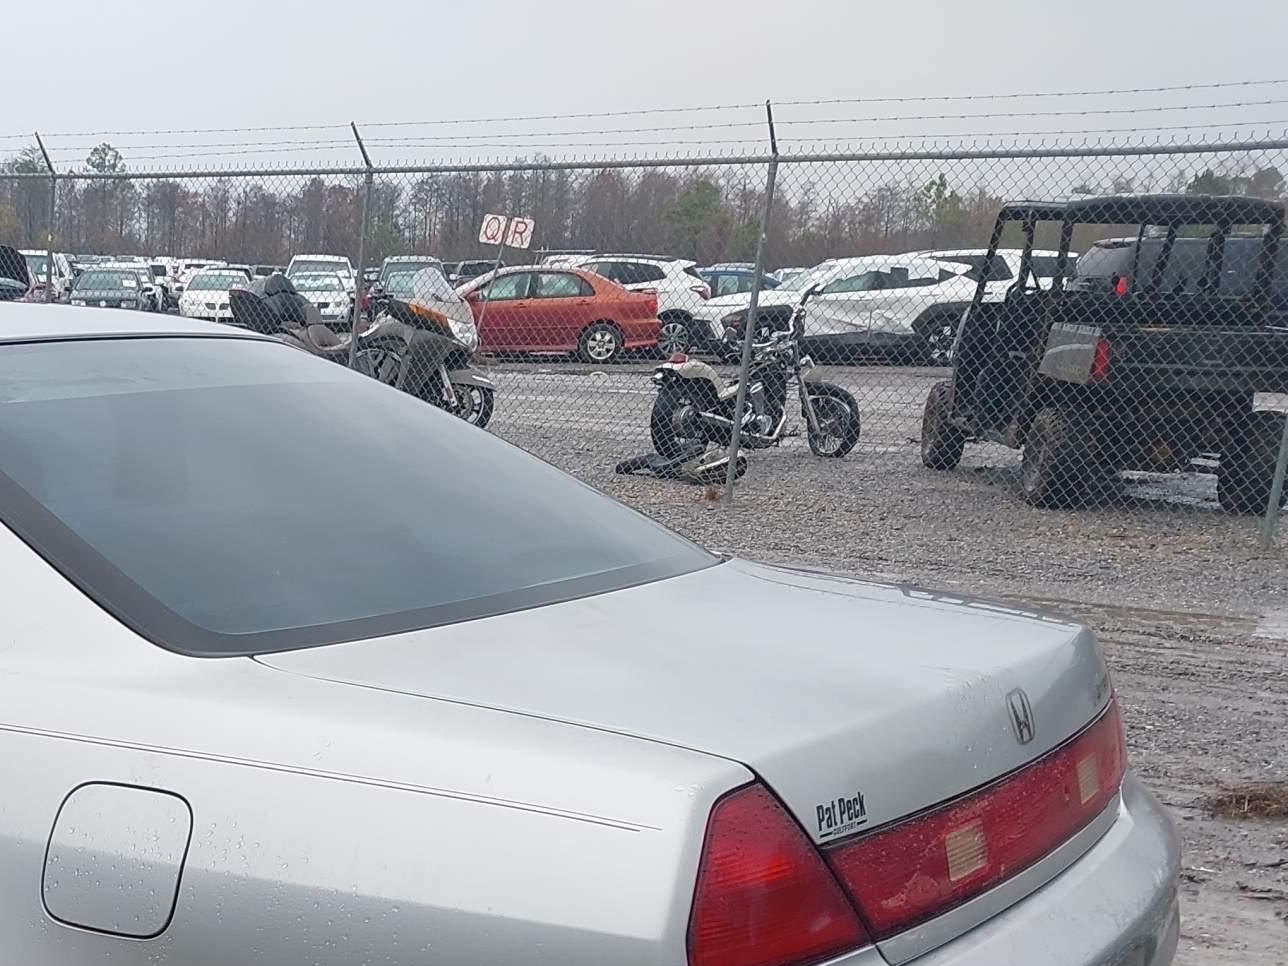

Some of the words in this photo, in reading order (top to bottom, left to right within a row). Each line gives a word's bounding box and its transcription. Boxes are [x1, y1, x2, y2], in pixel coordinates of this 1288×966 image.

[485, 217, 500, 242] Q
[512, 222, 528, 245] R
[816, 801, 838, 831] Pat
[838, 792, 866, 824] Peck
